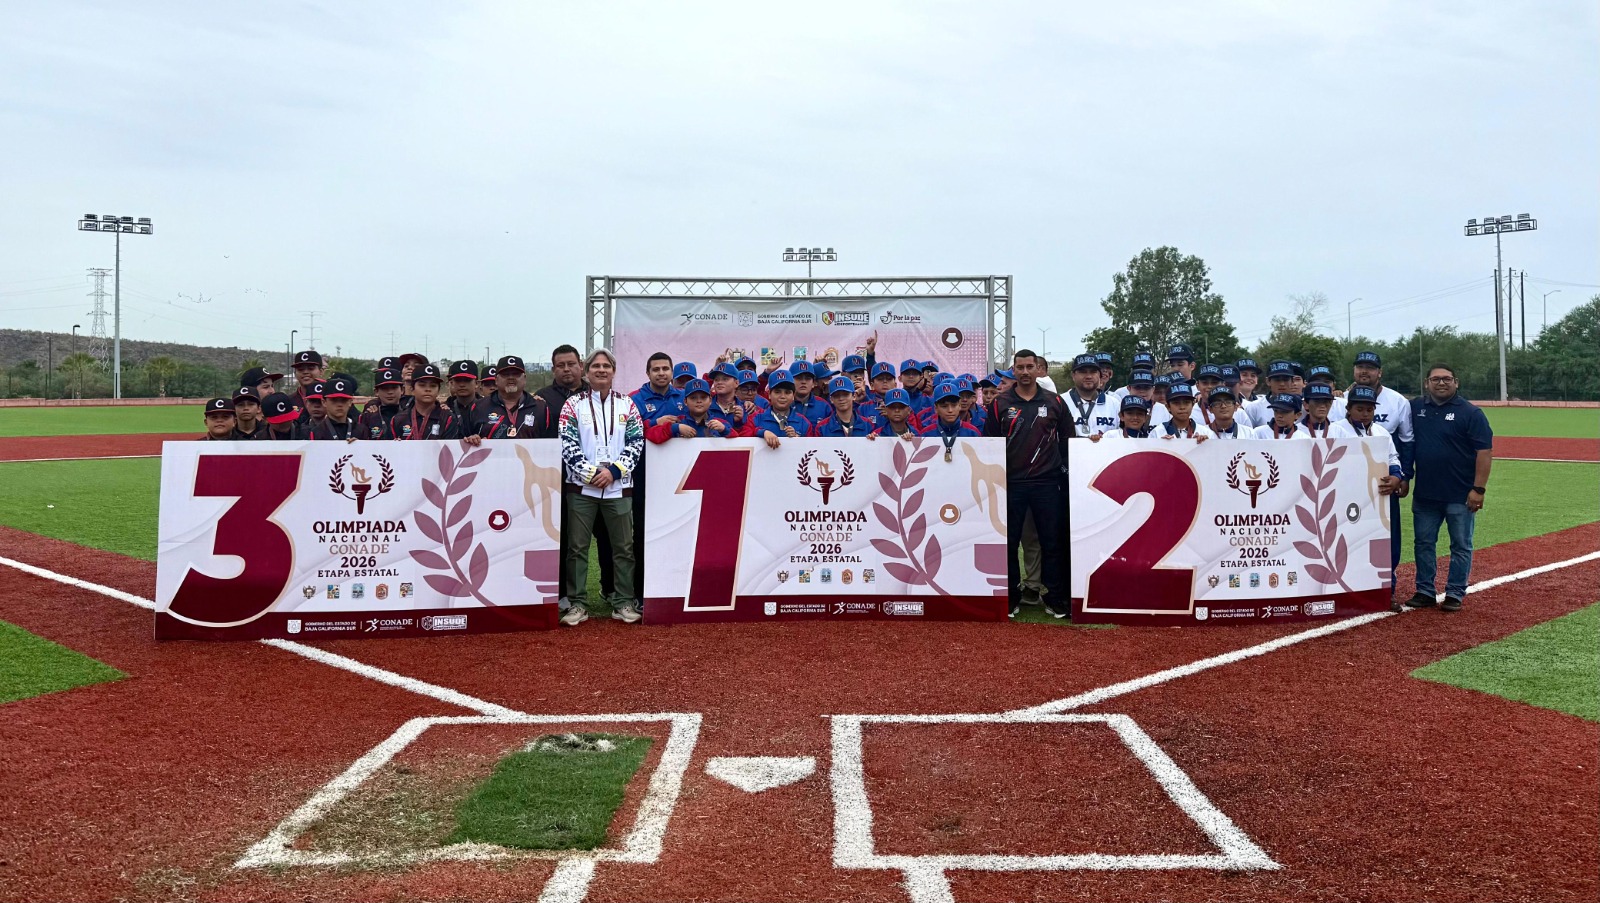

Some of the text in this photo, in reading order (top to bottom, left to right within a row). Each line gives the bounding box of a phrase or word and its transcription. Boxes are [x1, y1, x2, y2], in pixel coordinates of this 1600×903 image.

[835, 313, 870, 321] INSUDE
[425, 366, 433, 374] C
[460, 362, 468, 371] C
[384, 371, 392, 379] C
[315, 384, 322, 392] C
[336, 382, 344, 391] C
[277, 402, 285, 412] C
[1096, 417, 1115, 426] PAZ
[1373, 414, 1389, 422] AZ
[784, 510, 867, 523] OLIMPIADA
[1214, 513, 1291, 527] OLIMPIADA
[312, 520, 407, 534] OLIMPIADA
[674, 446, 754, 612] 1
[790, 523, 862, 531] NACIONAL
[1082, 449, 1202, 614] 2
[1220, 527, 1287, 536] NACIONAL
[167, 451, 305, 627] 3
[318, 535, 401, 543] NACIONAL
[799, 532, 853, 542] CONADE
[1229, 535, 1279, 547] CONADE
[329, 543, 389, 555] CONADE
[810, 543, 842, 554] 2026
[1239, 547, 1269, 559] 2026
[340, 556, 377, 568] 2026
[790, 555, 862, 563] ETAPA ESTATAL
[1220, 558, 1287, 568] ETAPA ESTATAL
[317, 568, 400, 578] ETAPA ESTATAL
[434, 617, 466, 626] INSUDE
